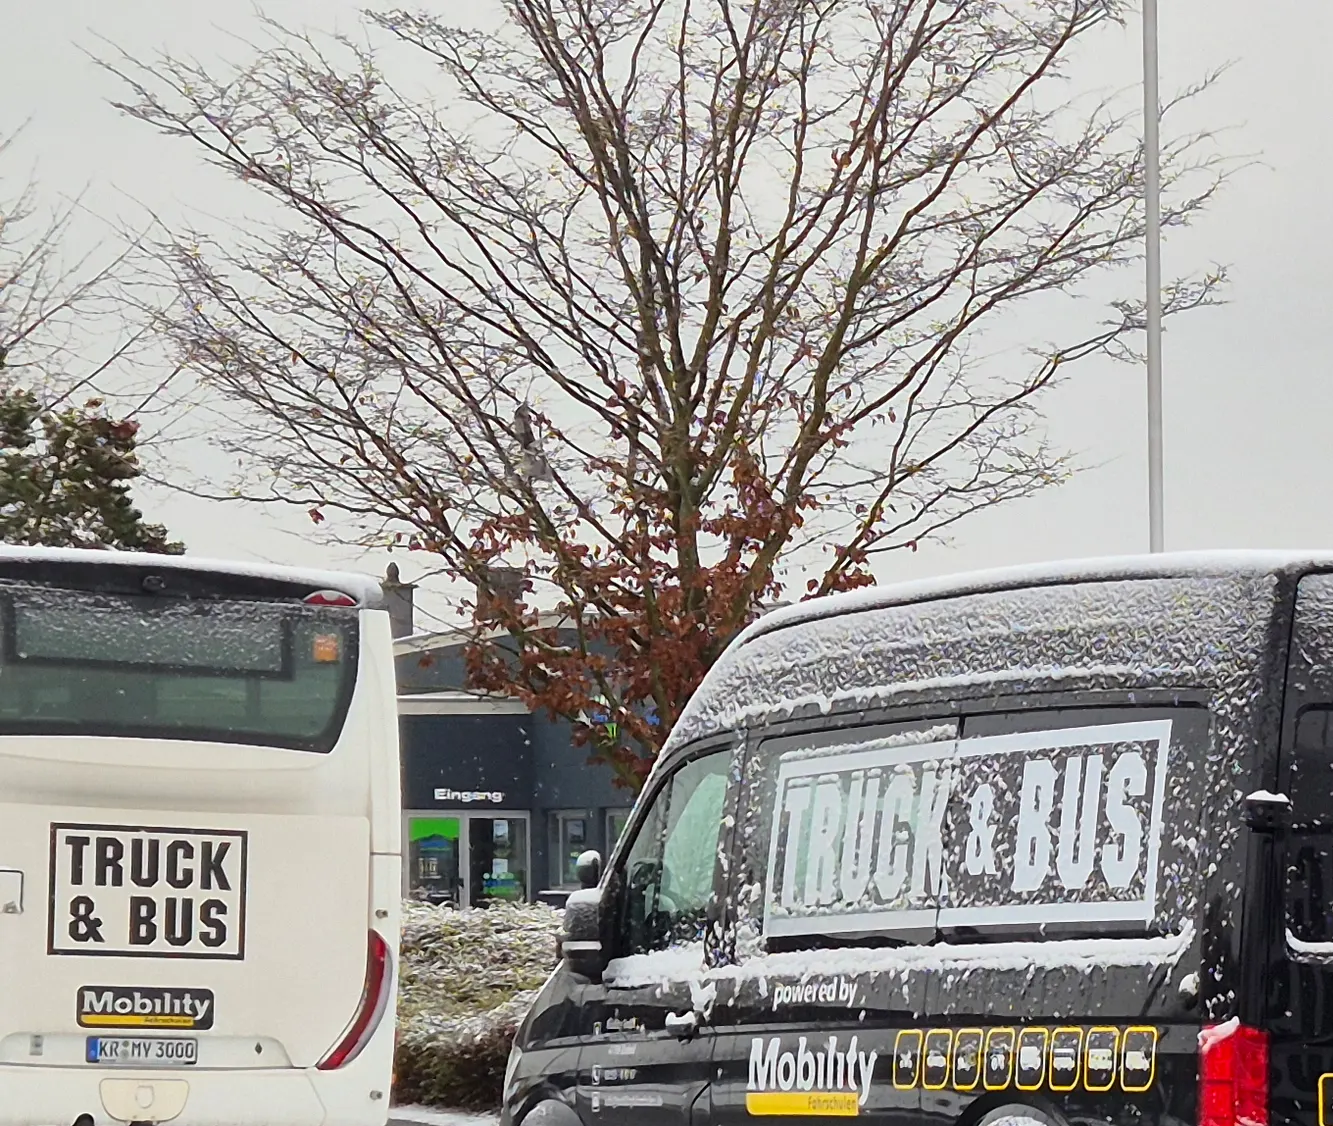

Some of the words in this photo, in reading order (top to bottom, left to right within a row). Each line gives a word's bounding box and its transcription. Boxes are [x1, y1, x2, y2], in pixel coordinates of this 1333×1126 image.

[434, 788, 503, 803] Eingang
[781, 762, 951, 910] TRUCK
[965, 784, 999, 876] &
[1012, 751, 1147, 892] BUS
[65, 835, 232, 891] TRUCK
[68, 895, 106, 943] &
[129, 896, 228, 947] BUS
[81, 990, 210, 1020] Mobility
[772, 976, 838, 1011] powered
[840, 976, 858, 1008] by
[99, 1041, 119, 1058] KR
[131, 1041, 152, 1058] MY
[155, 1042, 194, 1059] 3000
[746, 1035, 878, 1106] Mobility
